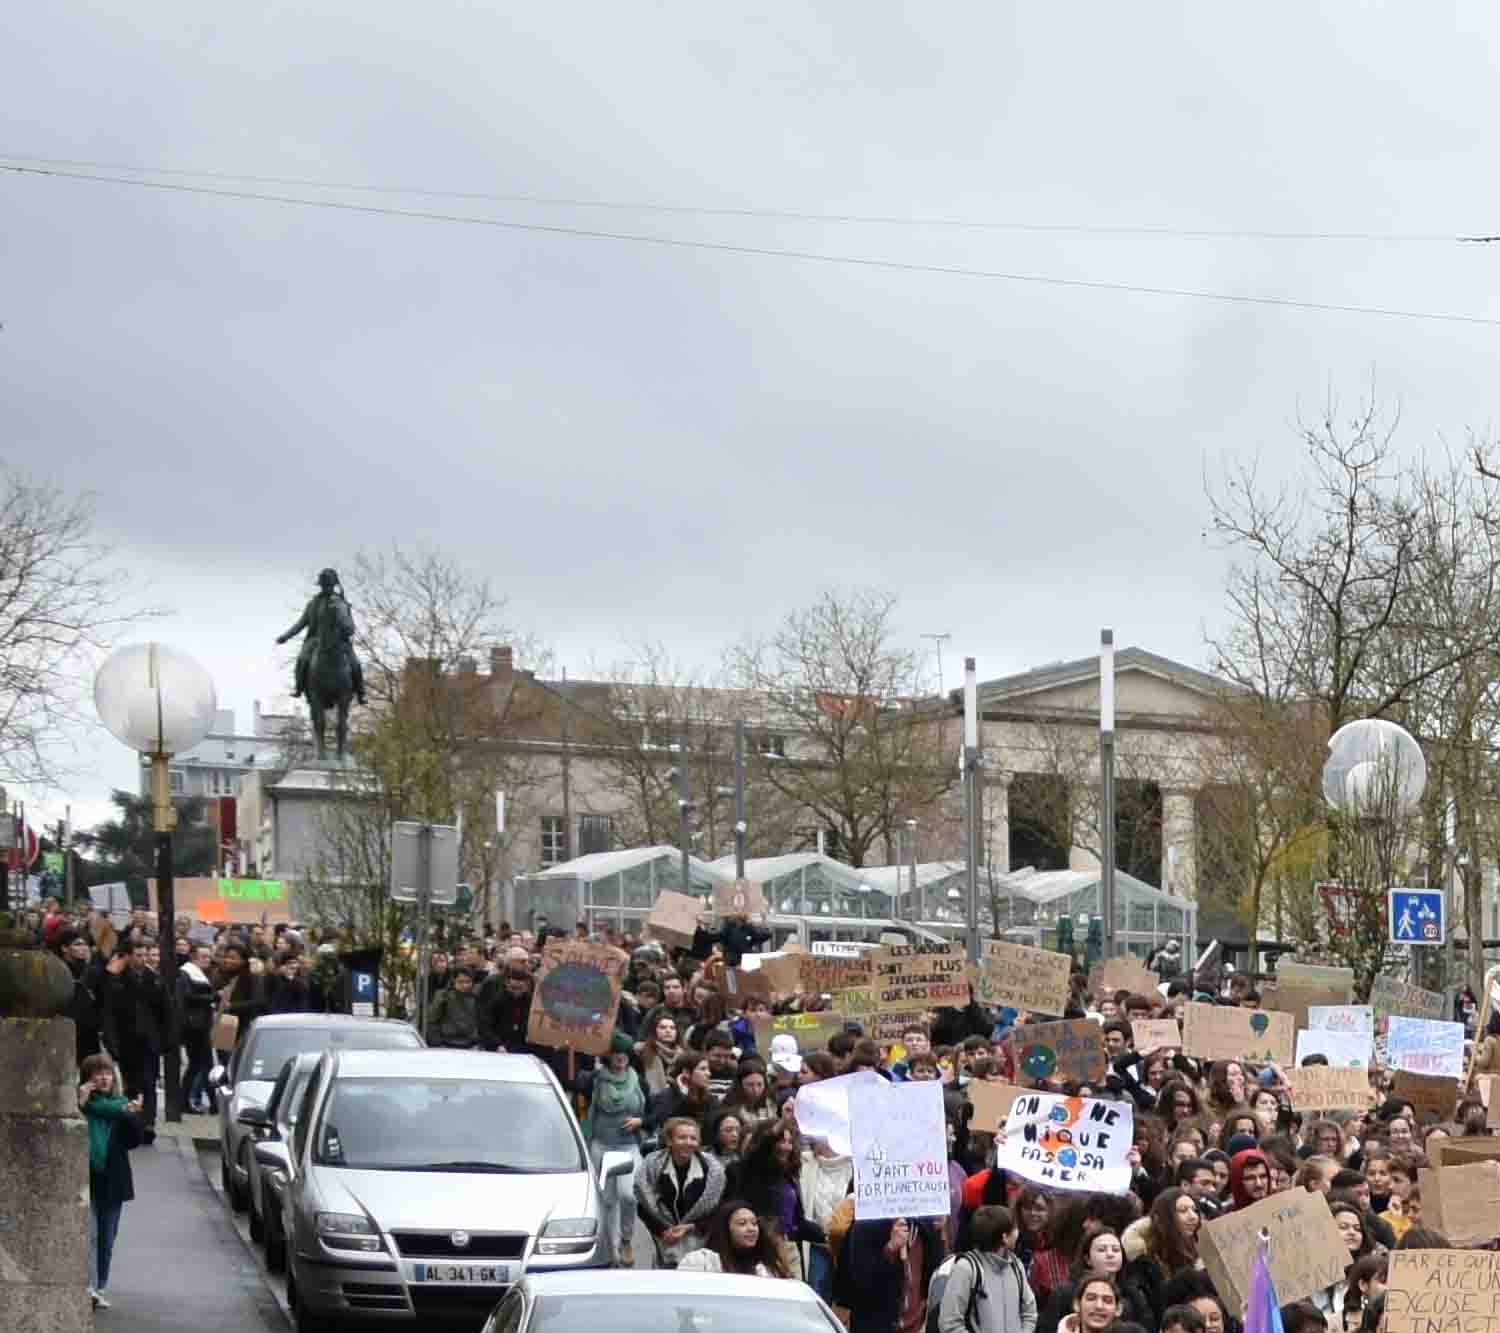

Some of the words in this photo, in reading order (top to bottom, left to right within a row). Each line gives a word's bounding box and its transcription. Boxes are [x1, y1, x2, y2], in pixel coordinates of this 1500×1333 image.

[932, 959, 961, 973] PLUS
[881, 987, 904, 1001] QUE
[906, 985, 928, 999] MES
[1015, 1096, 1040, 1116] ON
[1090, 1101, 1121, 1127] NE
[1021, 1147, 1056, 1164] PAS
[1079, 1152, 1105, 1171] SA
[871, 1162, 913, 1179] WANT
[916, 1162, 944, 1177] YOU
[1386, 1290, 1482, 1314] EXCUSE
